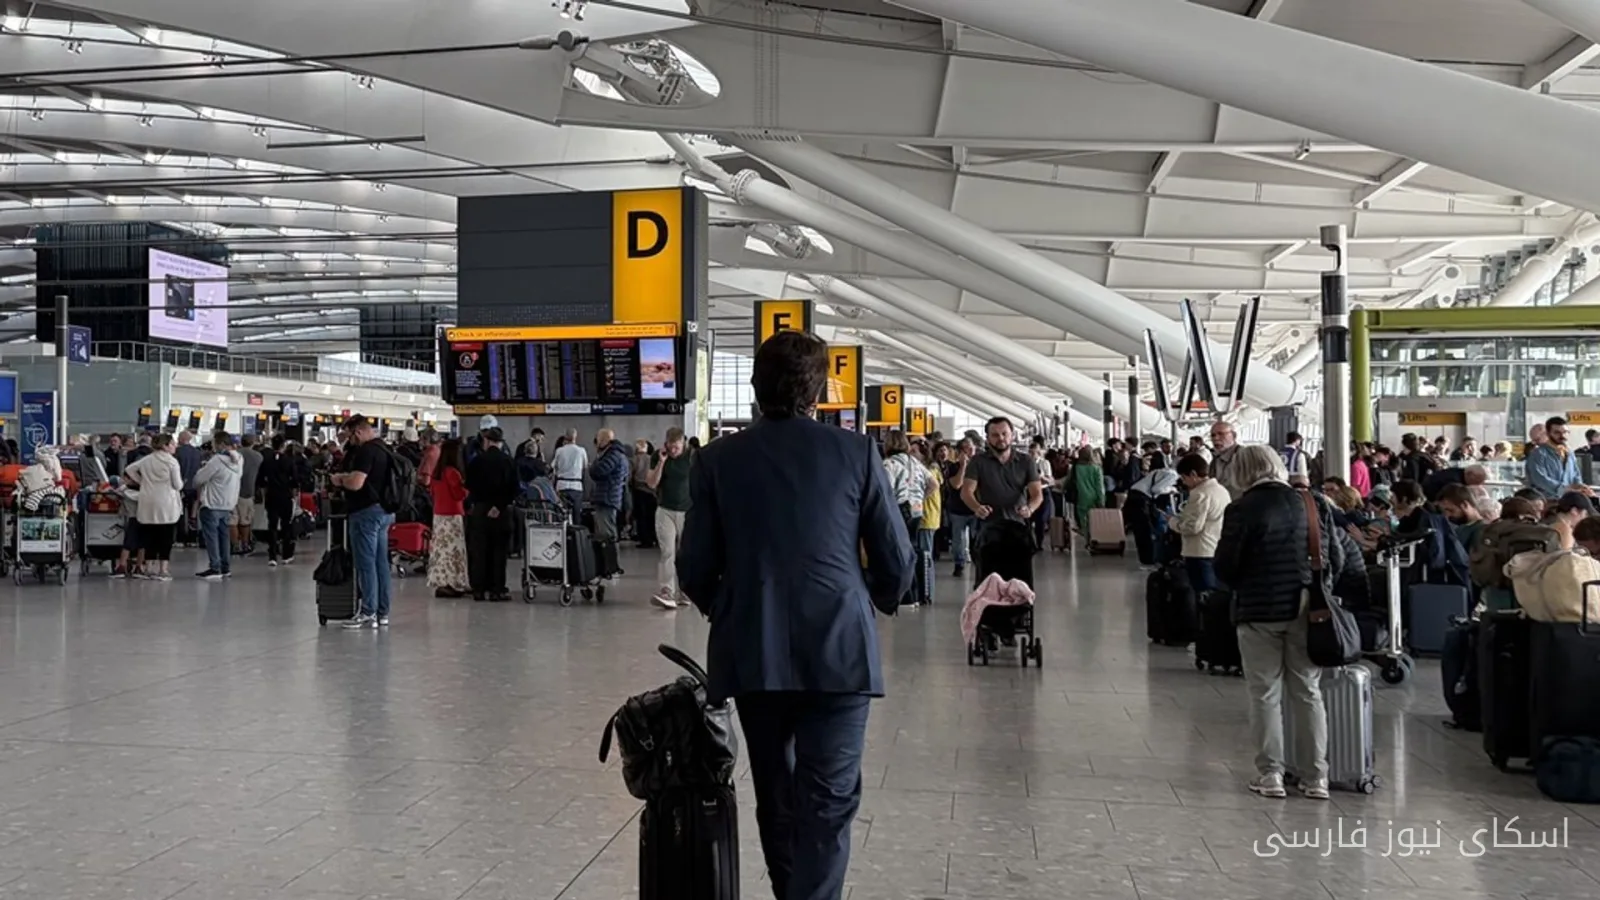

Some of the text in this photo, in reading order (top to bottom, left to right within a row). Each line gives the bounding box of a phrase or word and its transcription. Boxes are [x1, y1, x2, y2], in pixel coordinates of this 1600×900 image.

[627, 210, 669, 259] D
[835, 355, 848, 375] F
[884, 390, 897, 404] G
[913, 410, 923, 420] H
[1407, 414, 1428, 422] Lifts
[1572, 414, 1592, 422] Lifts
